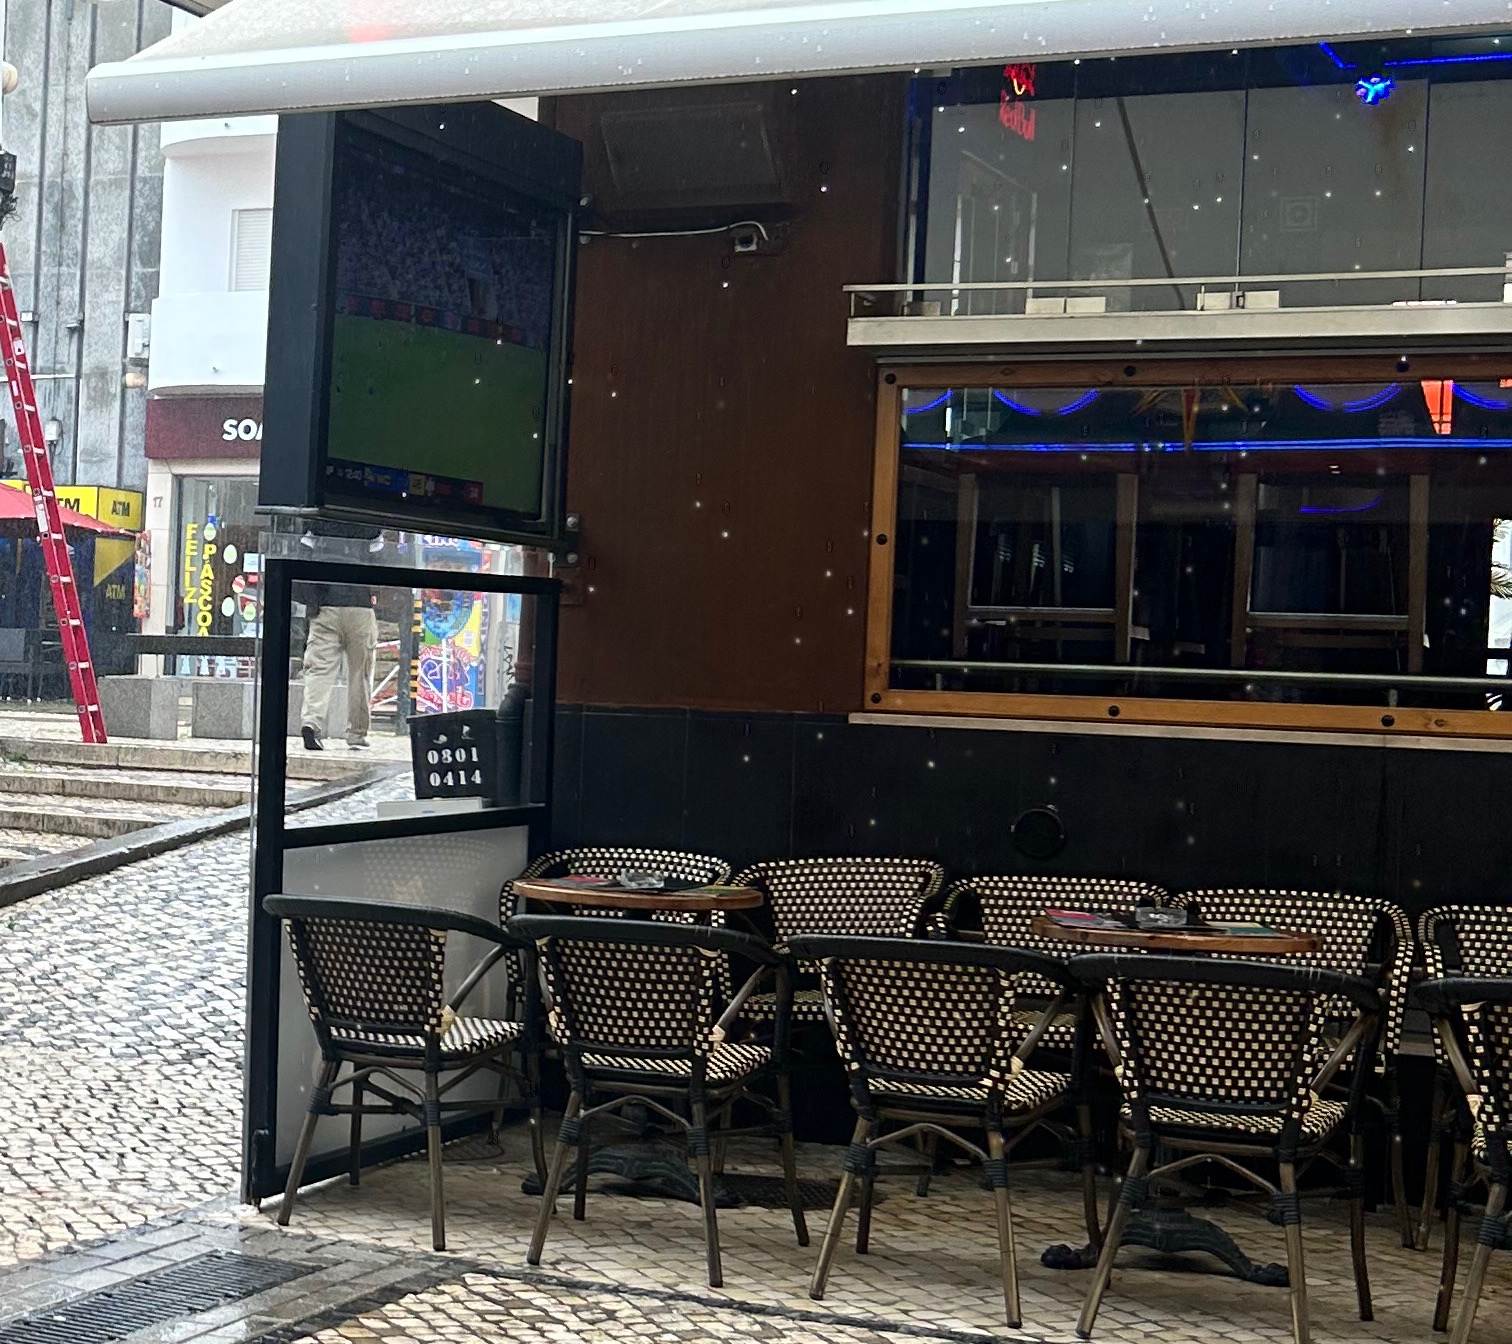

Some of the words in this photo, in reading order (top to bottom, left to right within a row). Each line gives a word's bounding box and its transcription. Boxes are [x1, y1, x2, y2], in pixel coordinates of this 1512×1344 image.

[111, 500, 130, 517] ATM
[153, 496, 163, 508] 17
[184, 523, 198, 603] FELIZ
[105, 584, 125, 600] ATM
[427, 747, 478, 764] 0801
[429, 769, 482, 787] 0414
